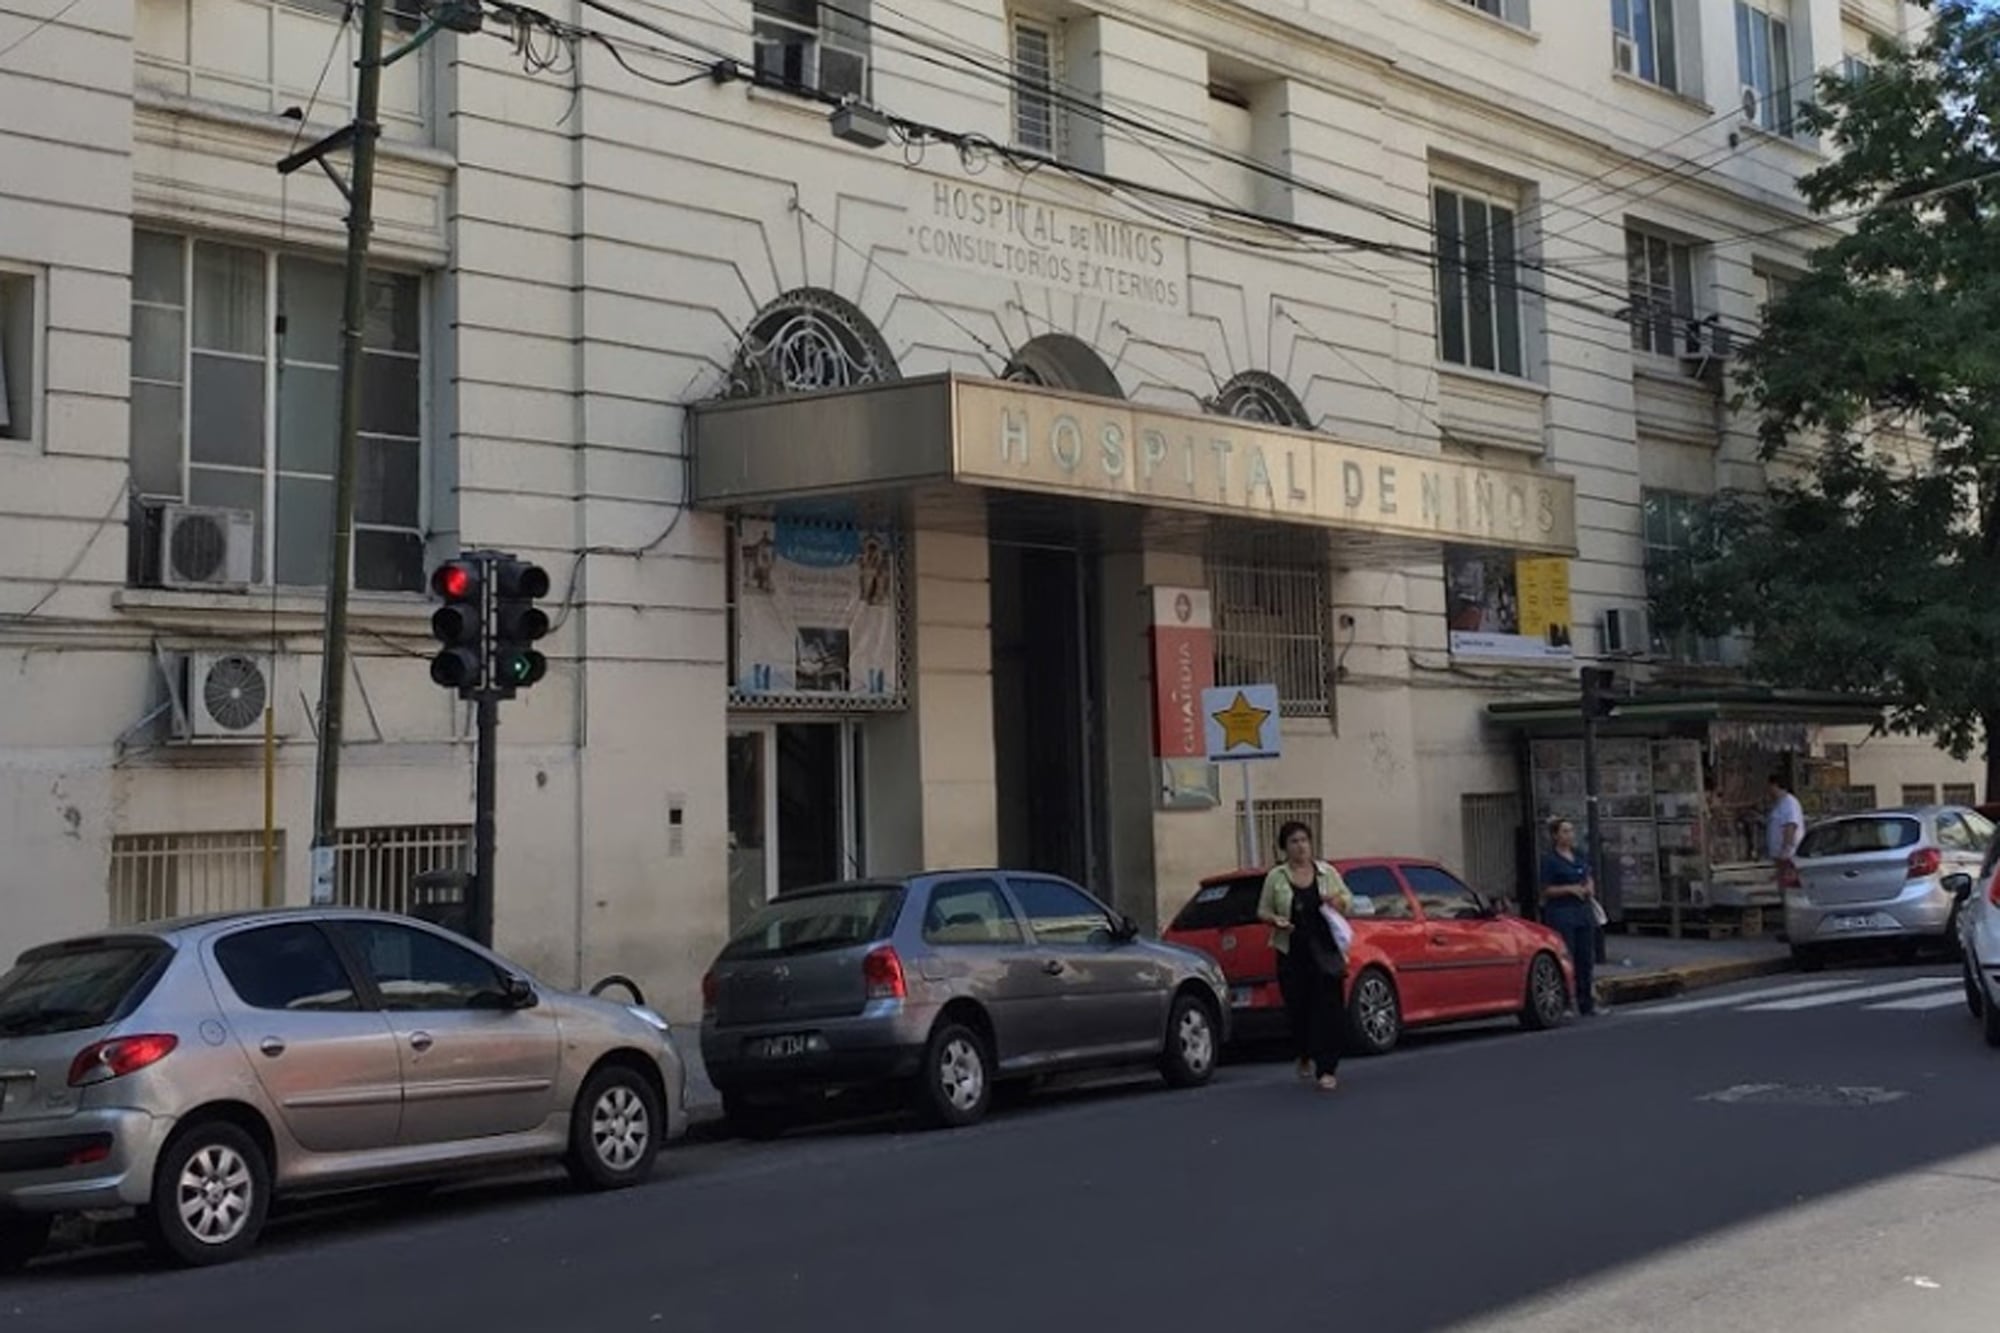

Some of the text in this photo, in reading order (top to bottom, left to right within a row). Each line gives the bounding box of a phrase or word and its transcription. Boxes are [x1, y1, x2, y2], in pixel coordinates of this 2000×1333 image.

[933, 182, 1064, 245] HOSPITAL
[1070, 225, 1089, 251] DE
[917, 226, 1179, 306] CONSULTORIOS EXTERNOS
[1000, 409, 1555, 534] HOSPITAL DE NIÑOS
